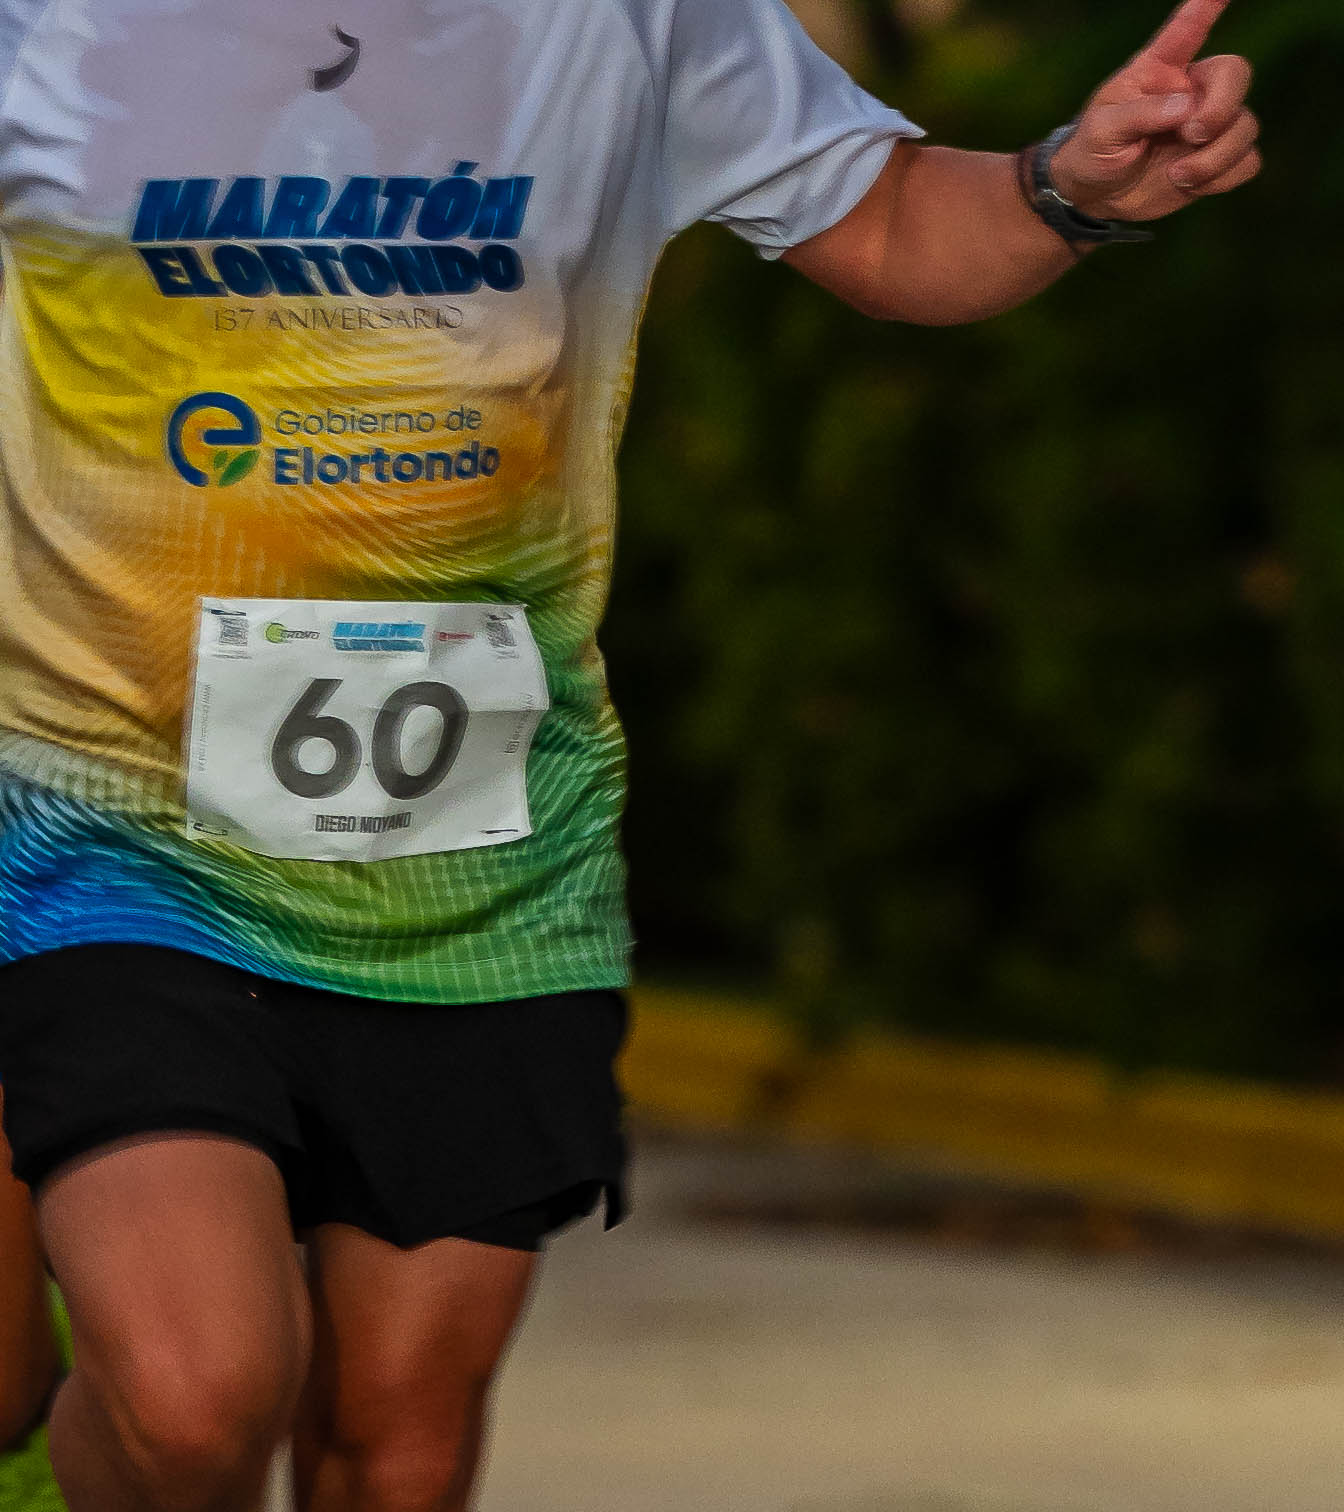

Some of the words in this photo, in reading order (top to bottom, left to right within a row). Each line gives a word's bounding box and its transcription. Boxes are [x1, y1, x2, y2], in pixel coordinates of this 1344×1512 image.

[131, 160, 535, 241] MARATÓN
[133, 242, 525, 298] ELORTONDO
[266, 306, 464, 331] ANIVERSARIO
[274, 406, 436, 436] Gobierno
[445, 405, 482, 432] de
[274, 440, 501, 486] Elortondo
[271, 678, 470, 801] 60
[315, 814, 356, 833] DIEGO
[359, 811, 412, 834] MOYANO
